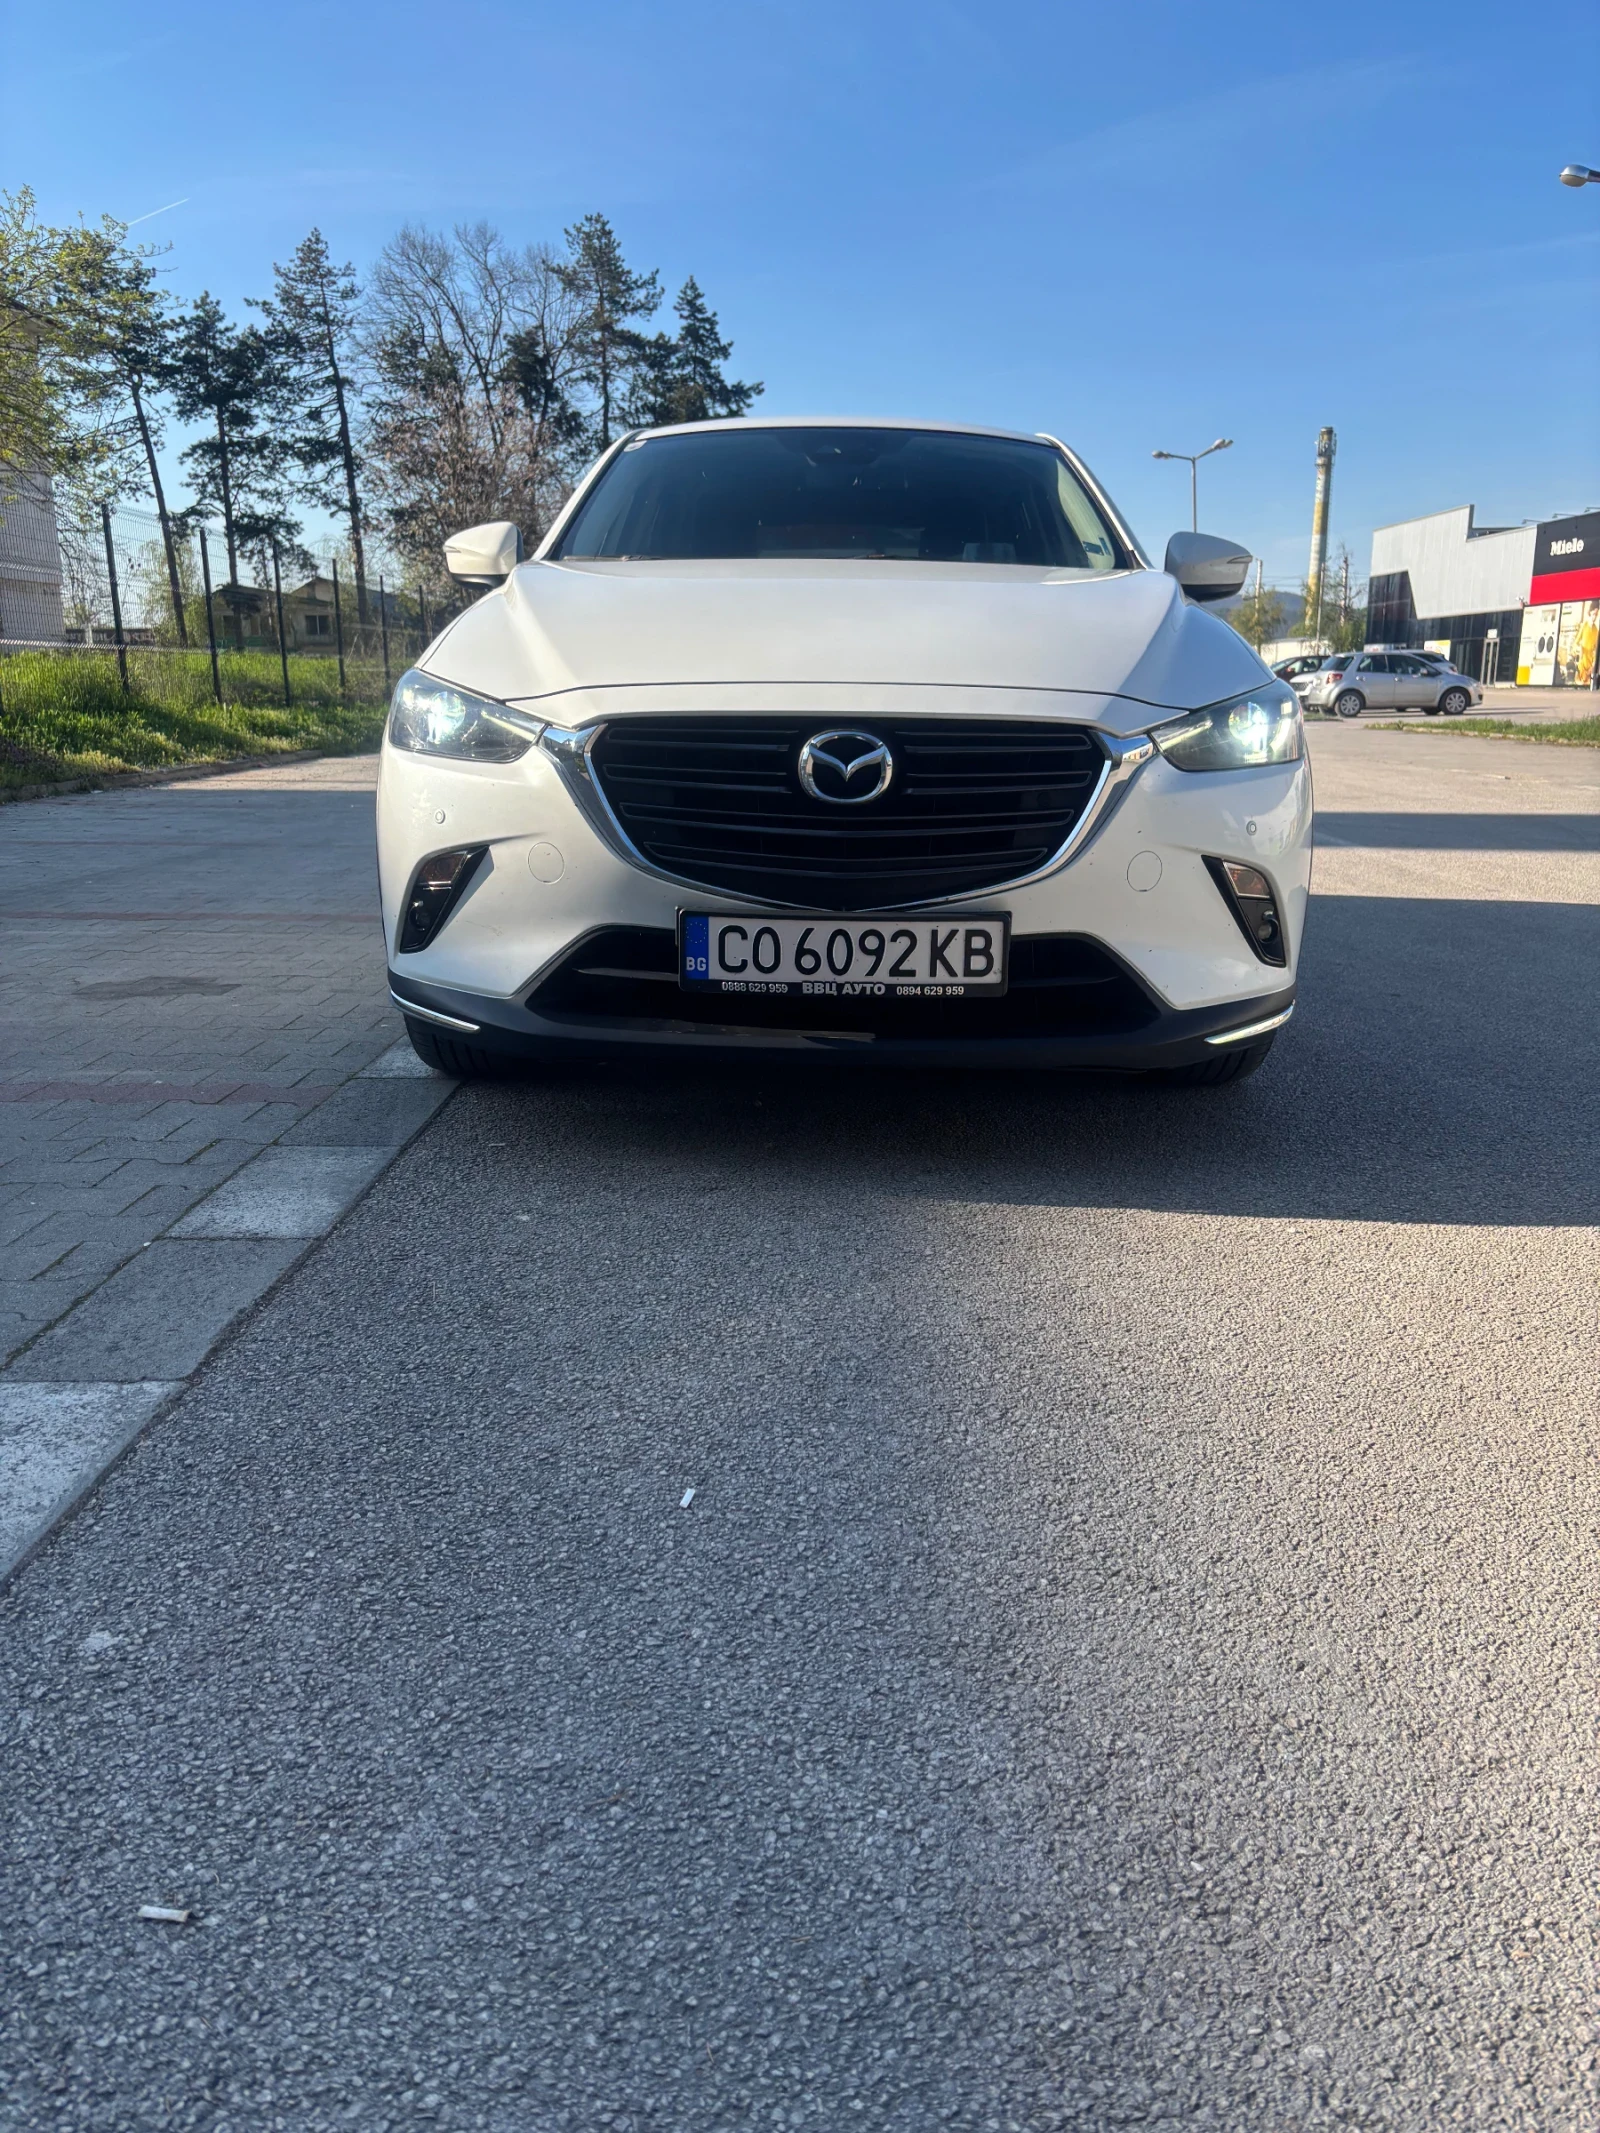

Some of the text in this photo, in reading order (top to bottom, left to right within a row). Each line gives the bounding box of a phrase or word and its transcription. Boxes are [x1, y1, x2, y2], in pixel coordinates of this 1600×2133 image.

[1550, 537, 1584, 556] Miele
[794, 927, 918, 977] 6092
[929, 929, 995, 978] KB
[685, 956, 707, 972] BG
[721, 981, 788, 994] 0888 629 959
[802, 982, 886, 996] ВВЦ АУТО
[896, 985, 965, 996] 0894 629 959
